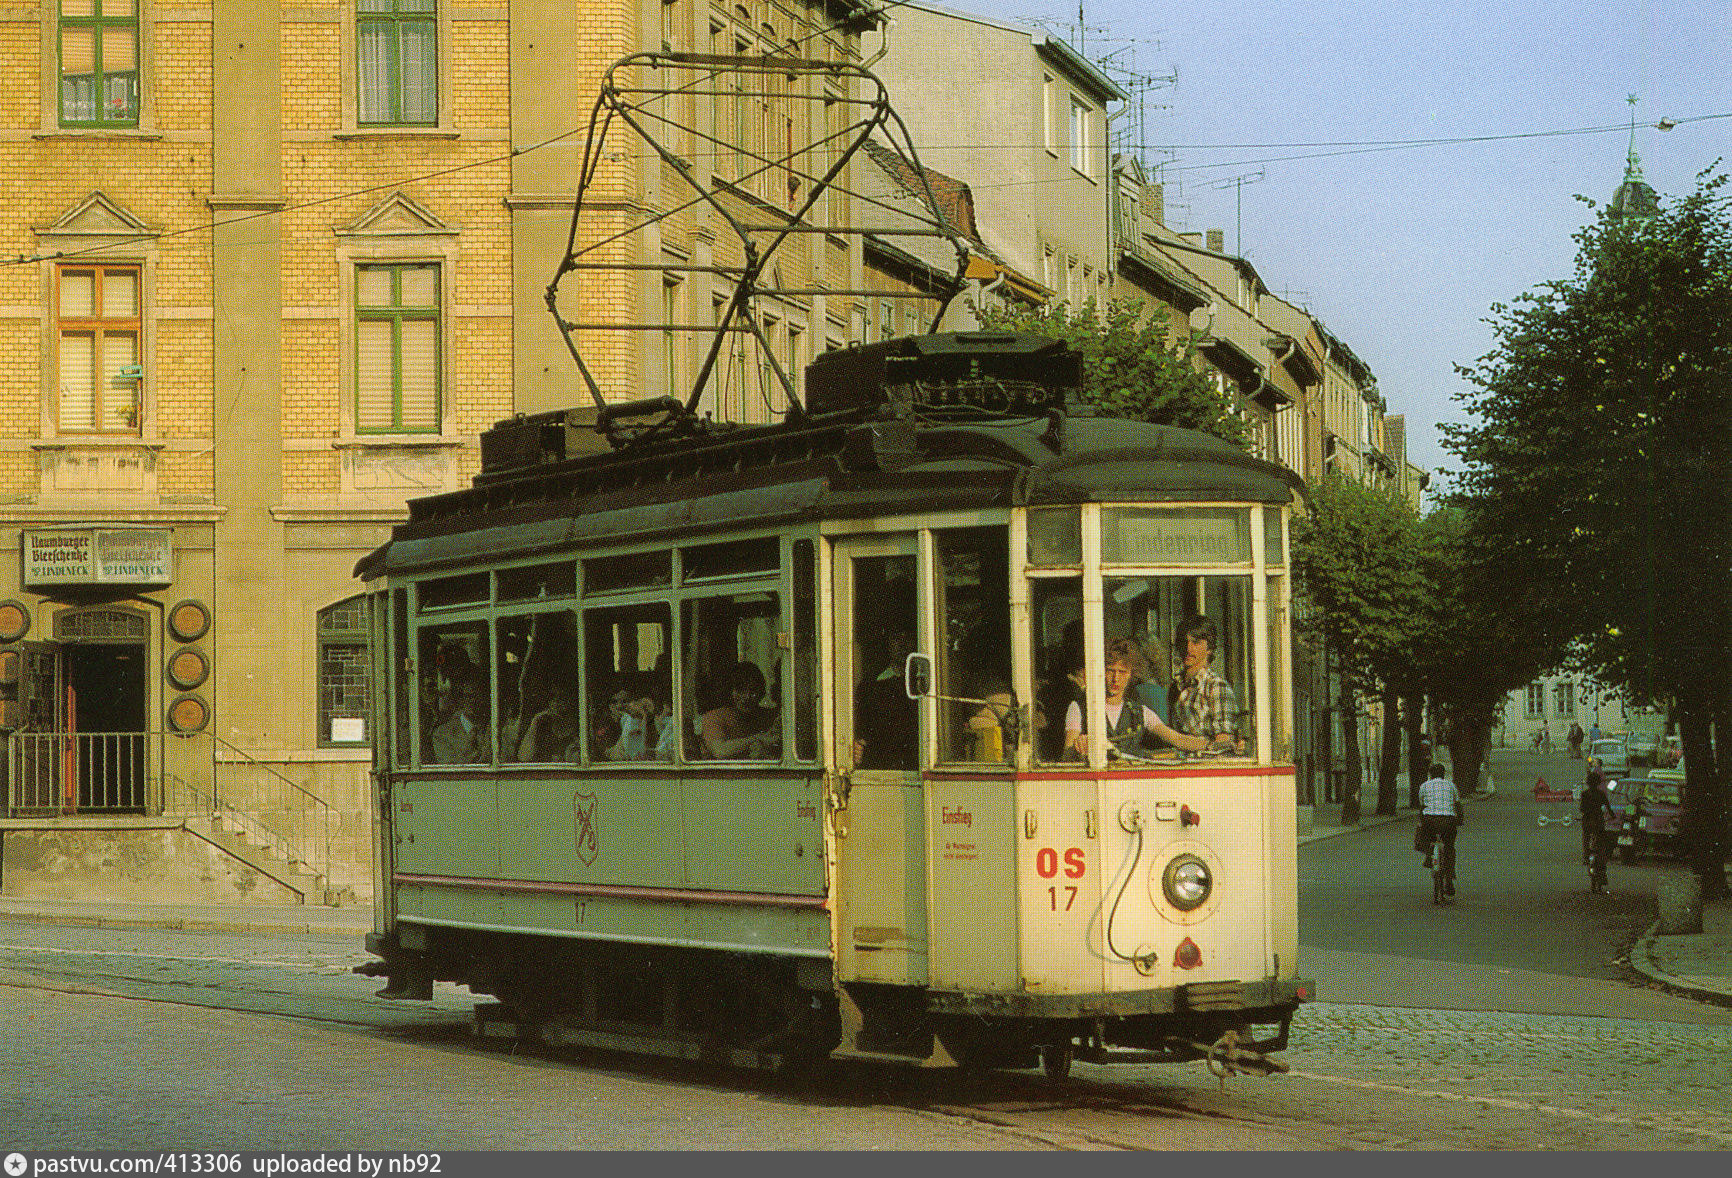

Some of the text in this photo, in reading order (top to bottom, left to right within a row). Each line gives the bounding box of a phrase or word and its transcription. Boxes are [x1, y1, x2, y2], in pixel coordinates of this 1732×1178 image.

[32, 536, 89, 550] Naumburger
[42, 565, 88, 576] LINDENECK
[114, 565, 163, 576] LINDENECK
[1036, 847, 1086, 879] OS
[1048, 886, 1078, 912] 17
